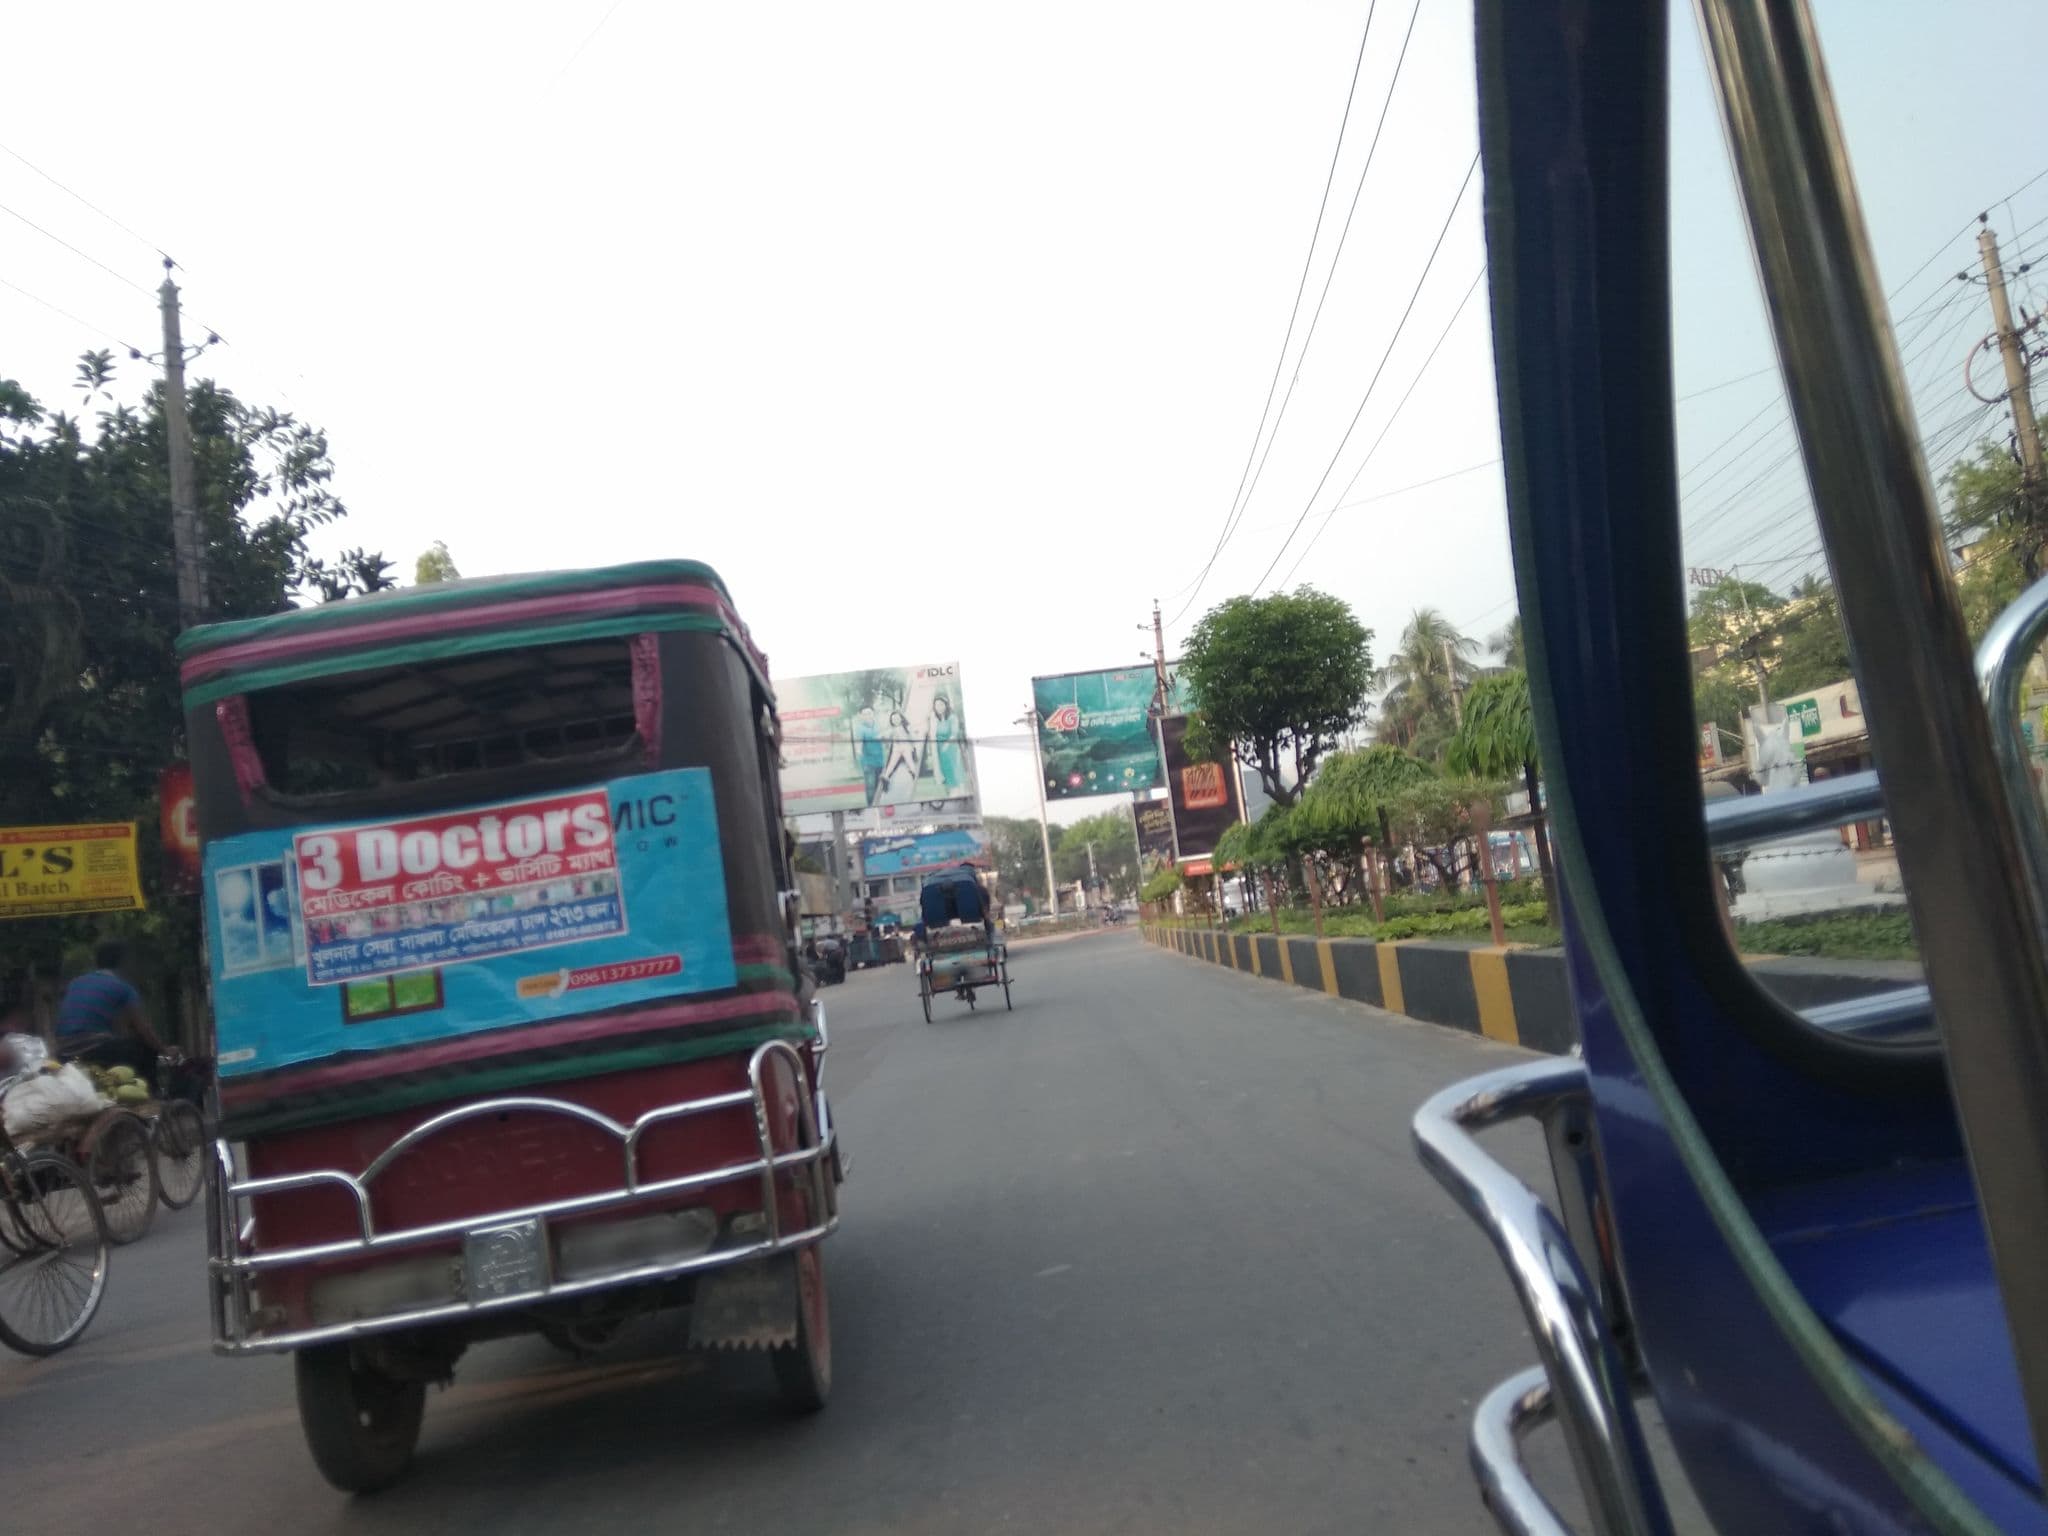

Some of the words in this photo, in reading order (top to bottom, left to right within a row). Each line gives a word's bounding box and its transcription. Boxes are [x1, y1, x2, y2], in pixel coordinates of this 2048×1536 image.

[927, 666, 954, 678] IDLC
[1045, 704, 1080, 731] 4G
[300, 835, 343, 890] 3
[356, 801, 611, 882] Doctors
[16, 880, 71, 897] Batch
[303, 888, 395, 914] মেডিকেল
[402, 871, 465, 898] কোচিং
